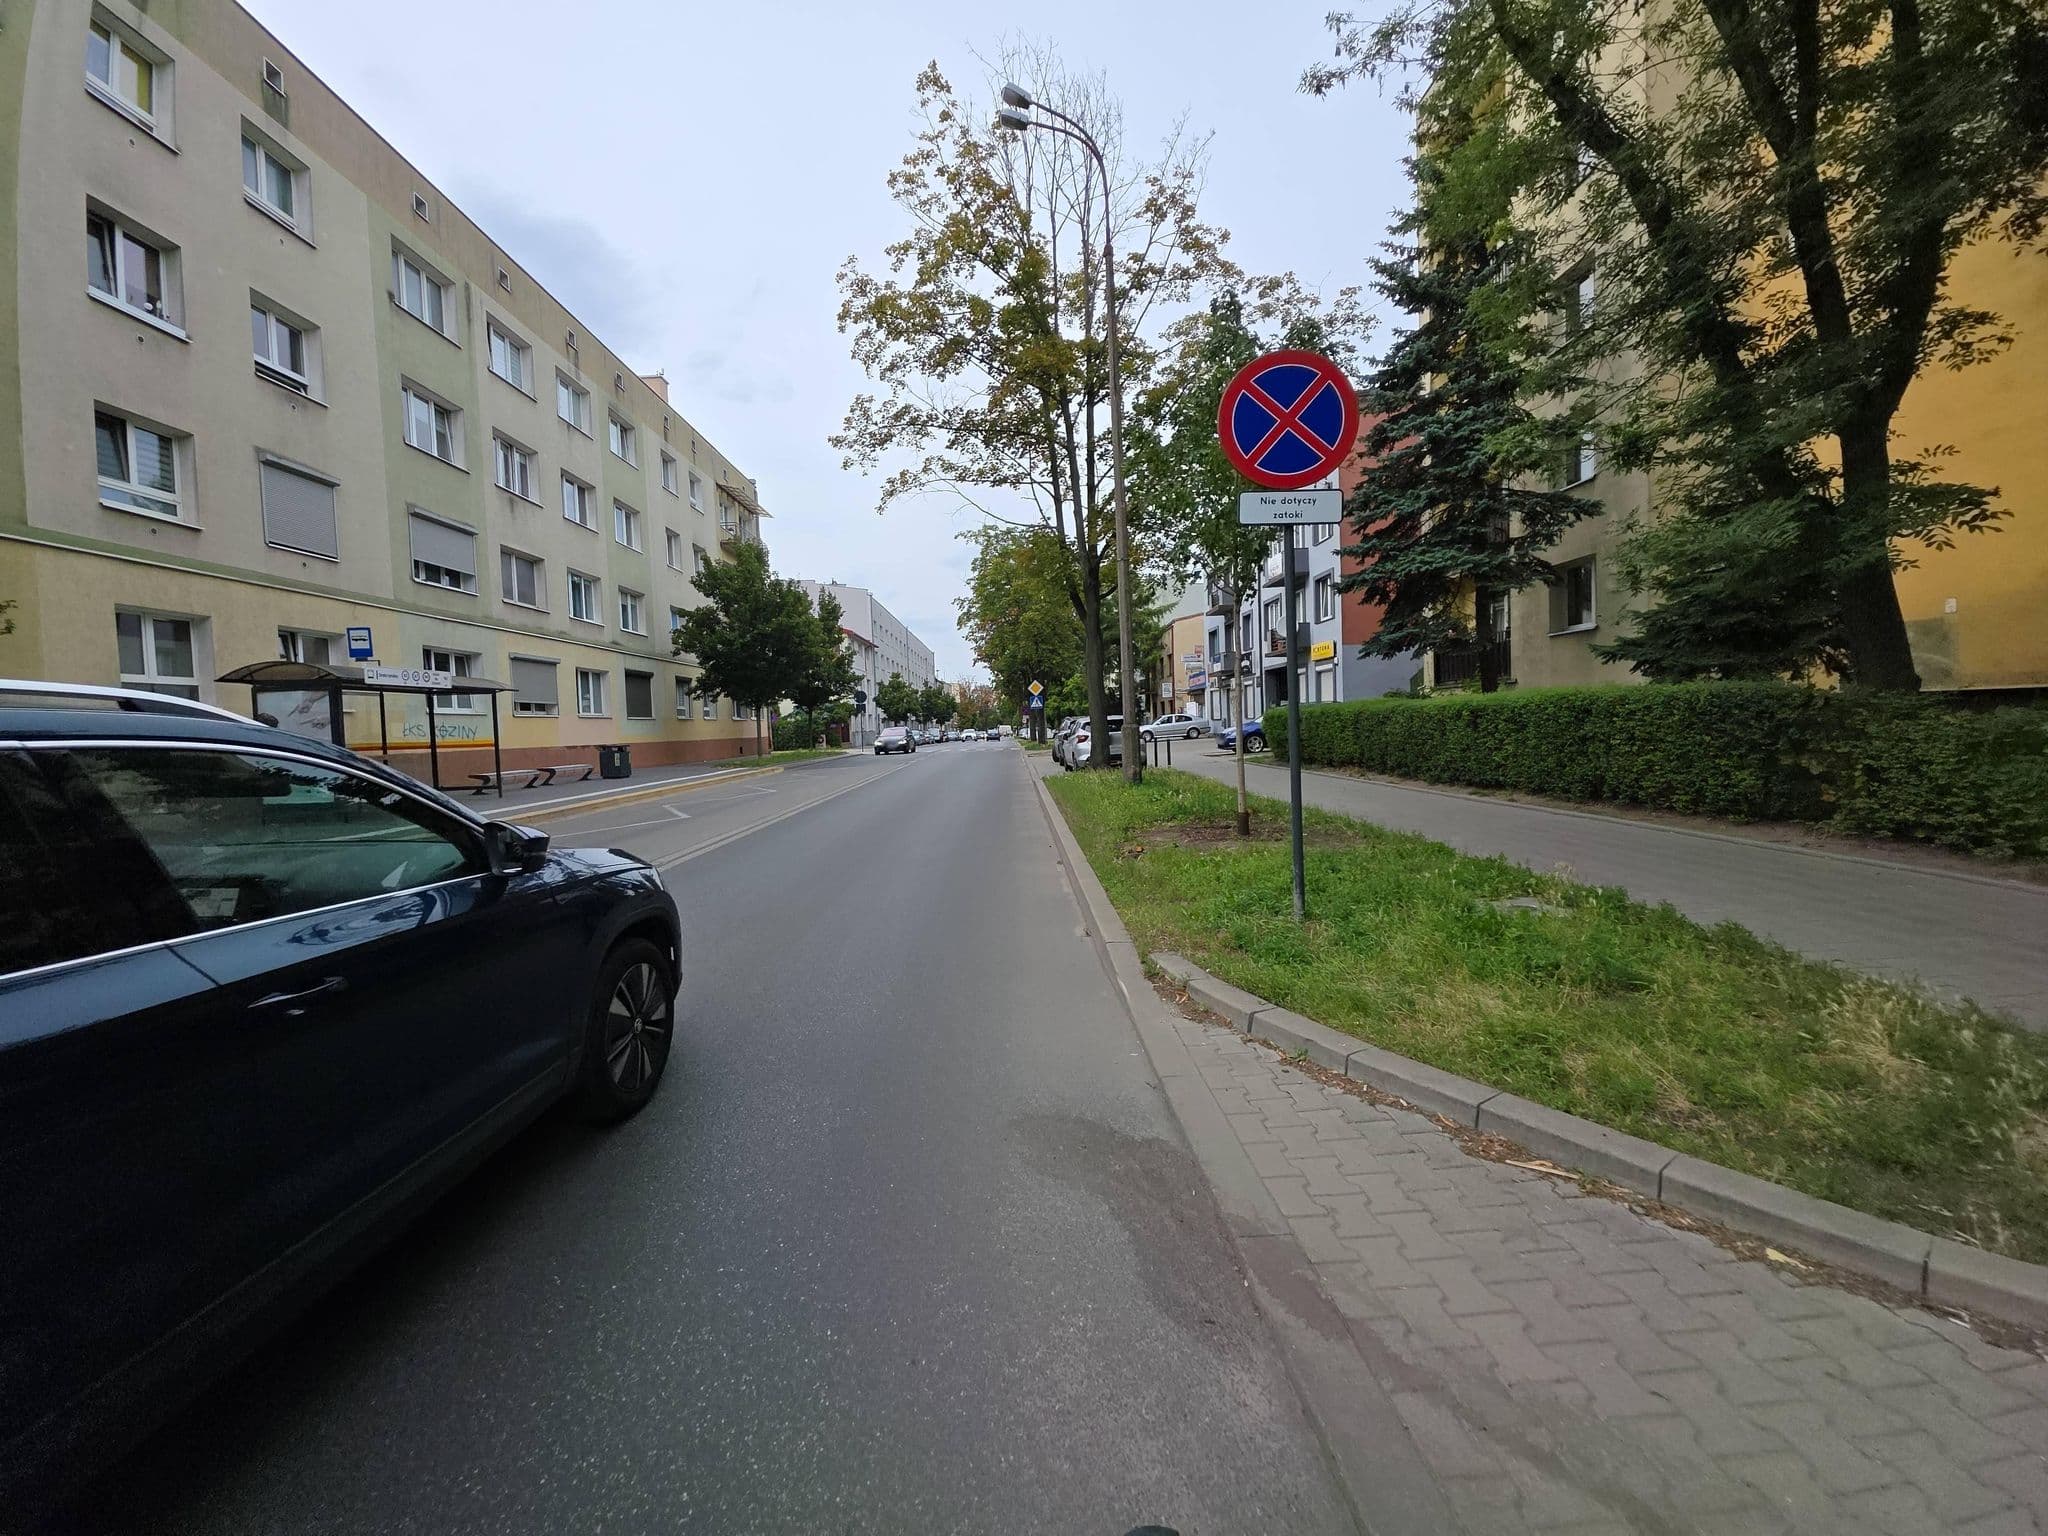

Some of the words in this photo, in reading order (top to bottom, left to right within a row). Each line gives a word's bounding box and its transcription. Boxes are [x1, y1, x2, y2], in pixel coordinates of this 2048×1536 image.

[1260, 497, 1277, 505] Nie
[1280, 497, 1317, 506] dotyczy
[1273, 511, 1303, 519] zatoki
